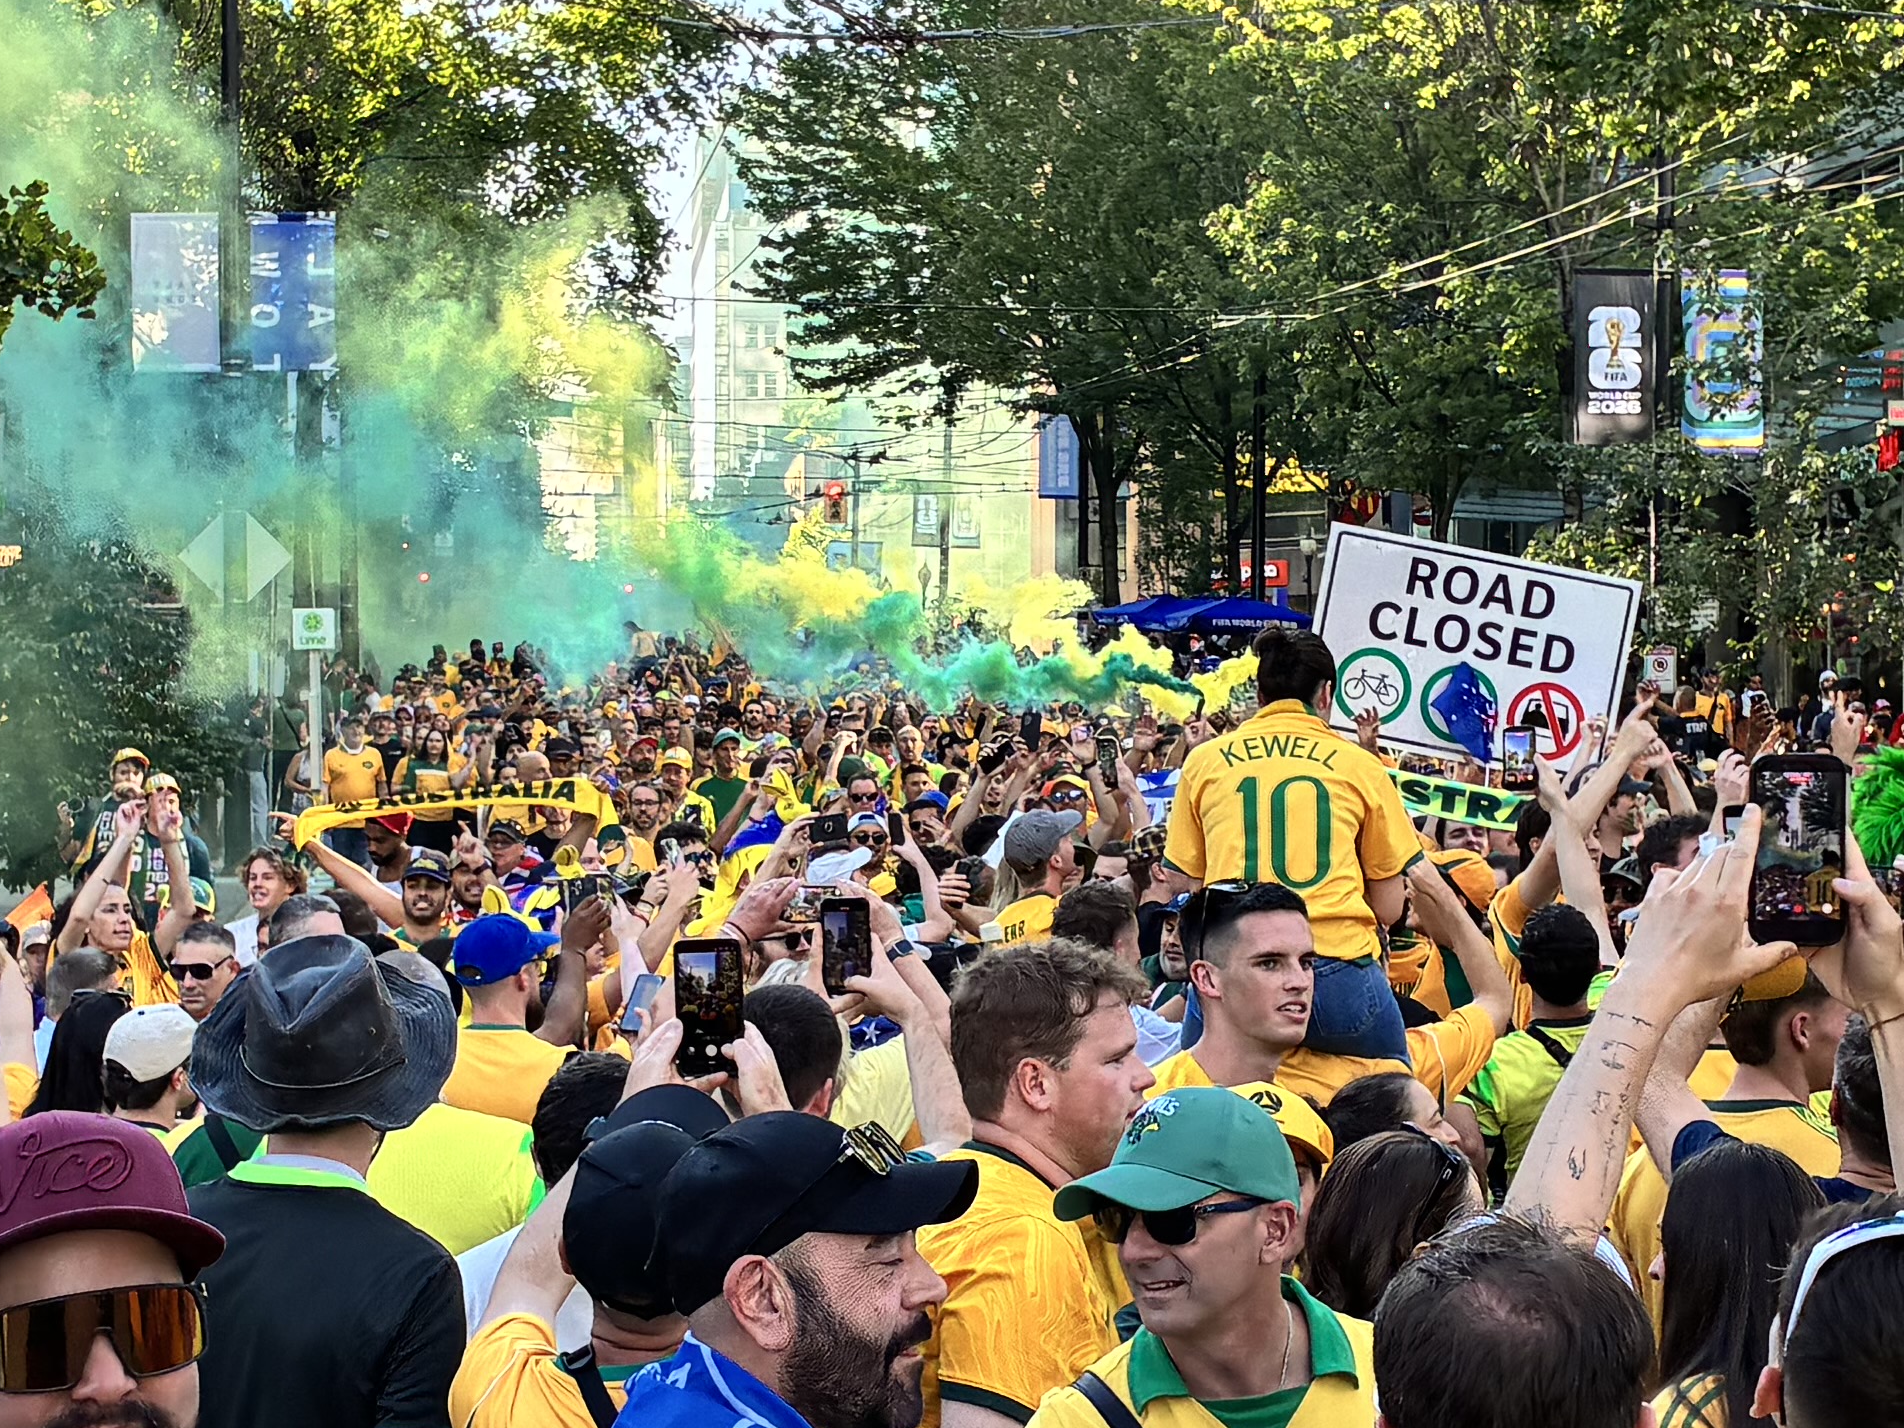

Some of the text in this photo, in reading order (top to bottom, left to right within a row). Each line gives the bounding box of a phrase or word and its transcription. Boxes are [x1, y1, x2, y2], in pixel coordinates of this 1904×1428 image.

[1587, 391, 1642, 400] WORLD CUP
[1603, 371, 1628, 382] FIFA
[1587, 400, 1642, 414] 2026
[1404, 556, 1556, 620] ROAD
[1368, 601, 1575, 674] CLOSED
[1219, 734, 1338, 772] KEWELL
[1236, 775, 1332, 890] 10
